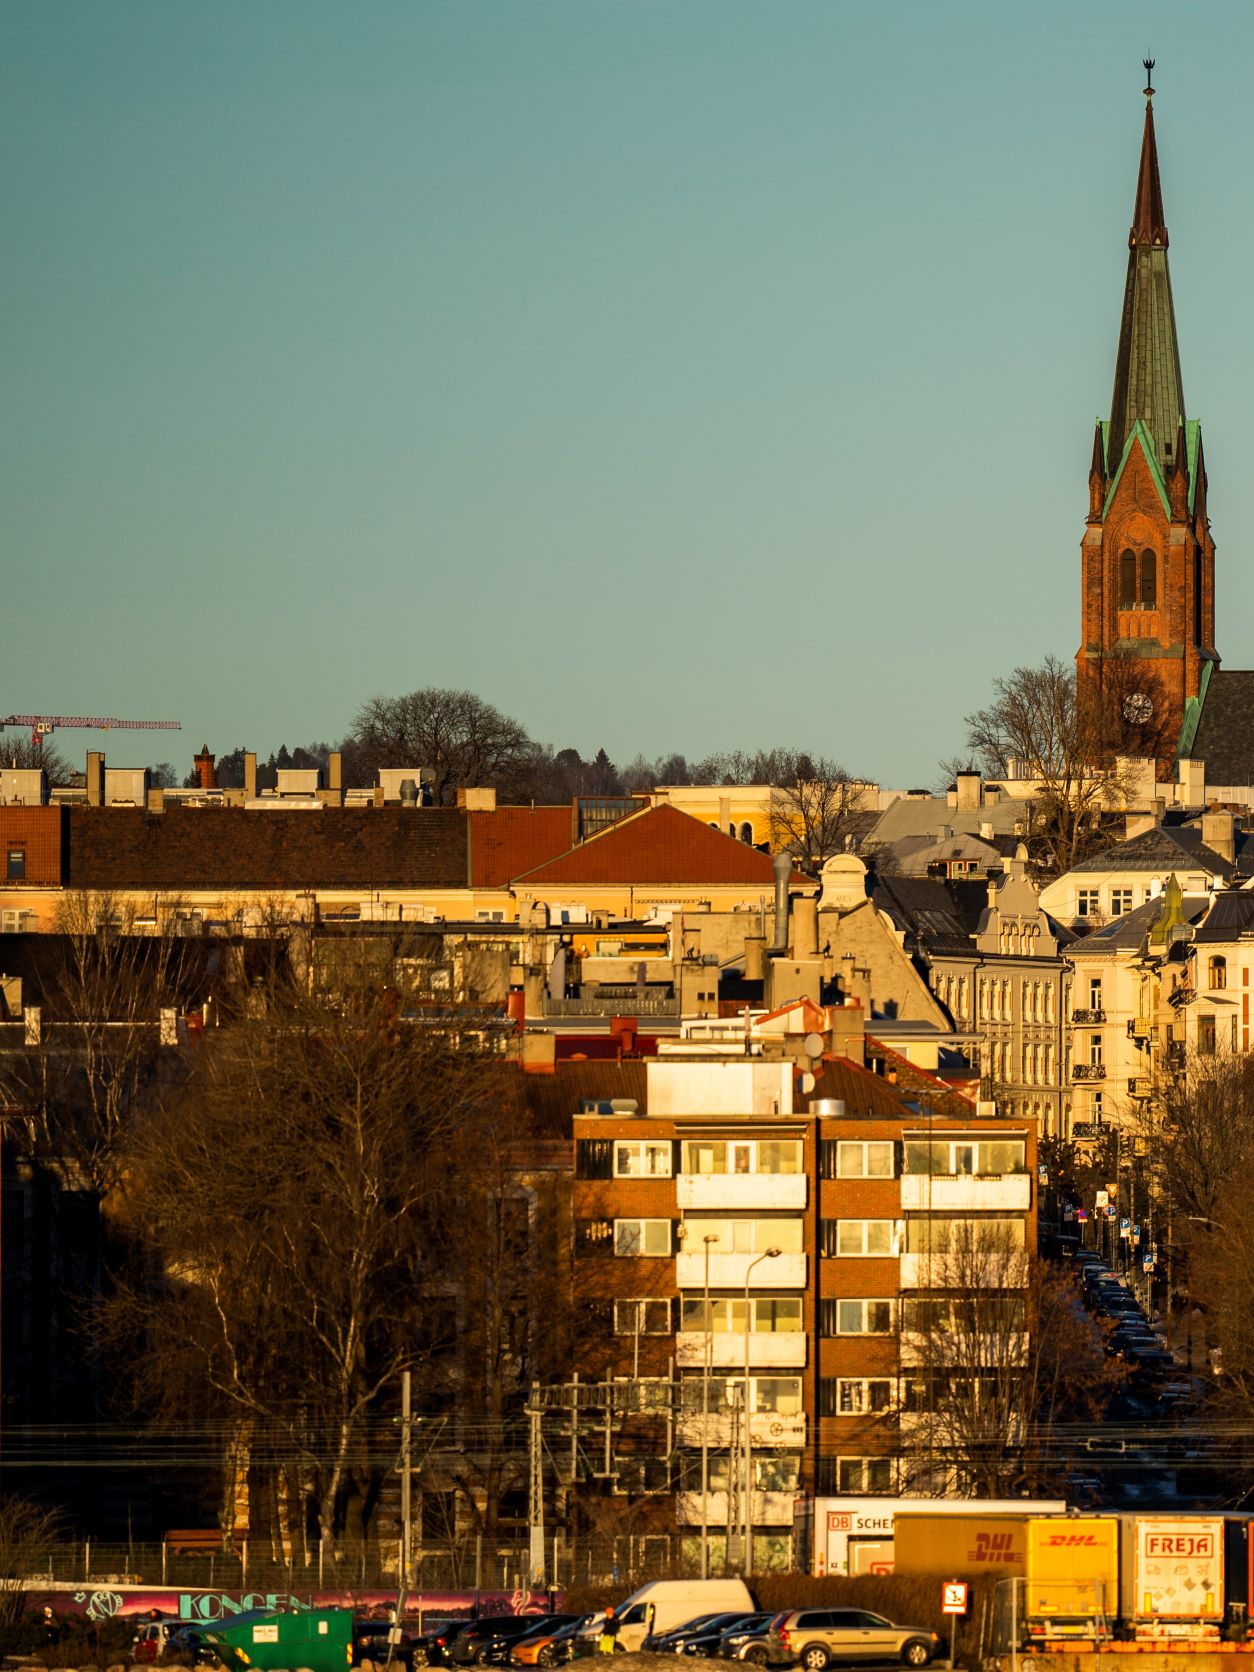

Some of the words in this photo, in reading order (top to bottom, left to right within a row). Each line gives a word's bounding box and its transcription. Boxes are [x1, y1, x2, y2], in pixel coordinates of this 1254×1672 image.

[832, 1517, 849, 1529] DB
[974, 1532, 1016, 1562] DHL
[1049, 1535, 1099, 1547] DHL
[1150, 1538, 1209, 1556] FREJA
